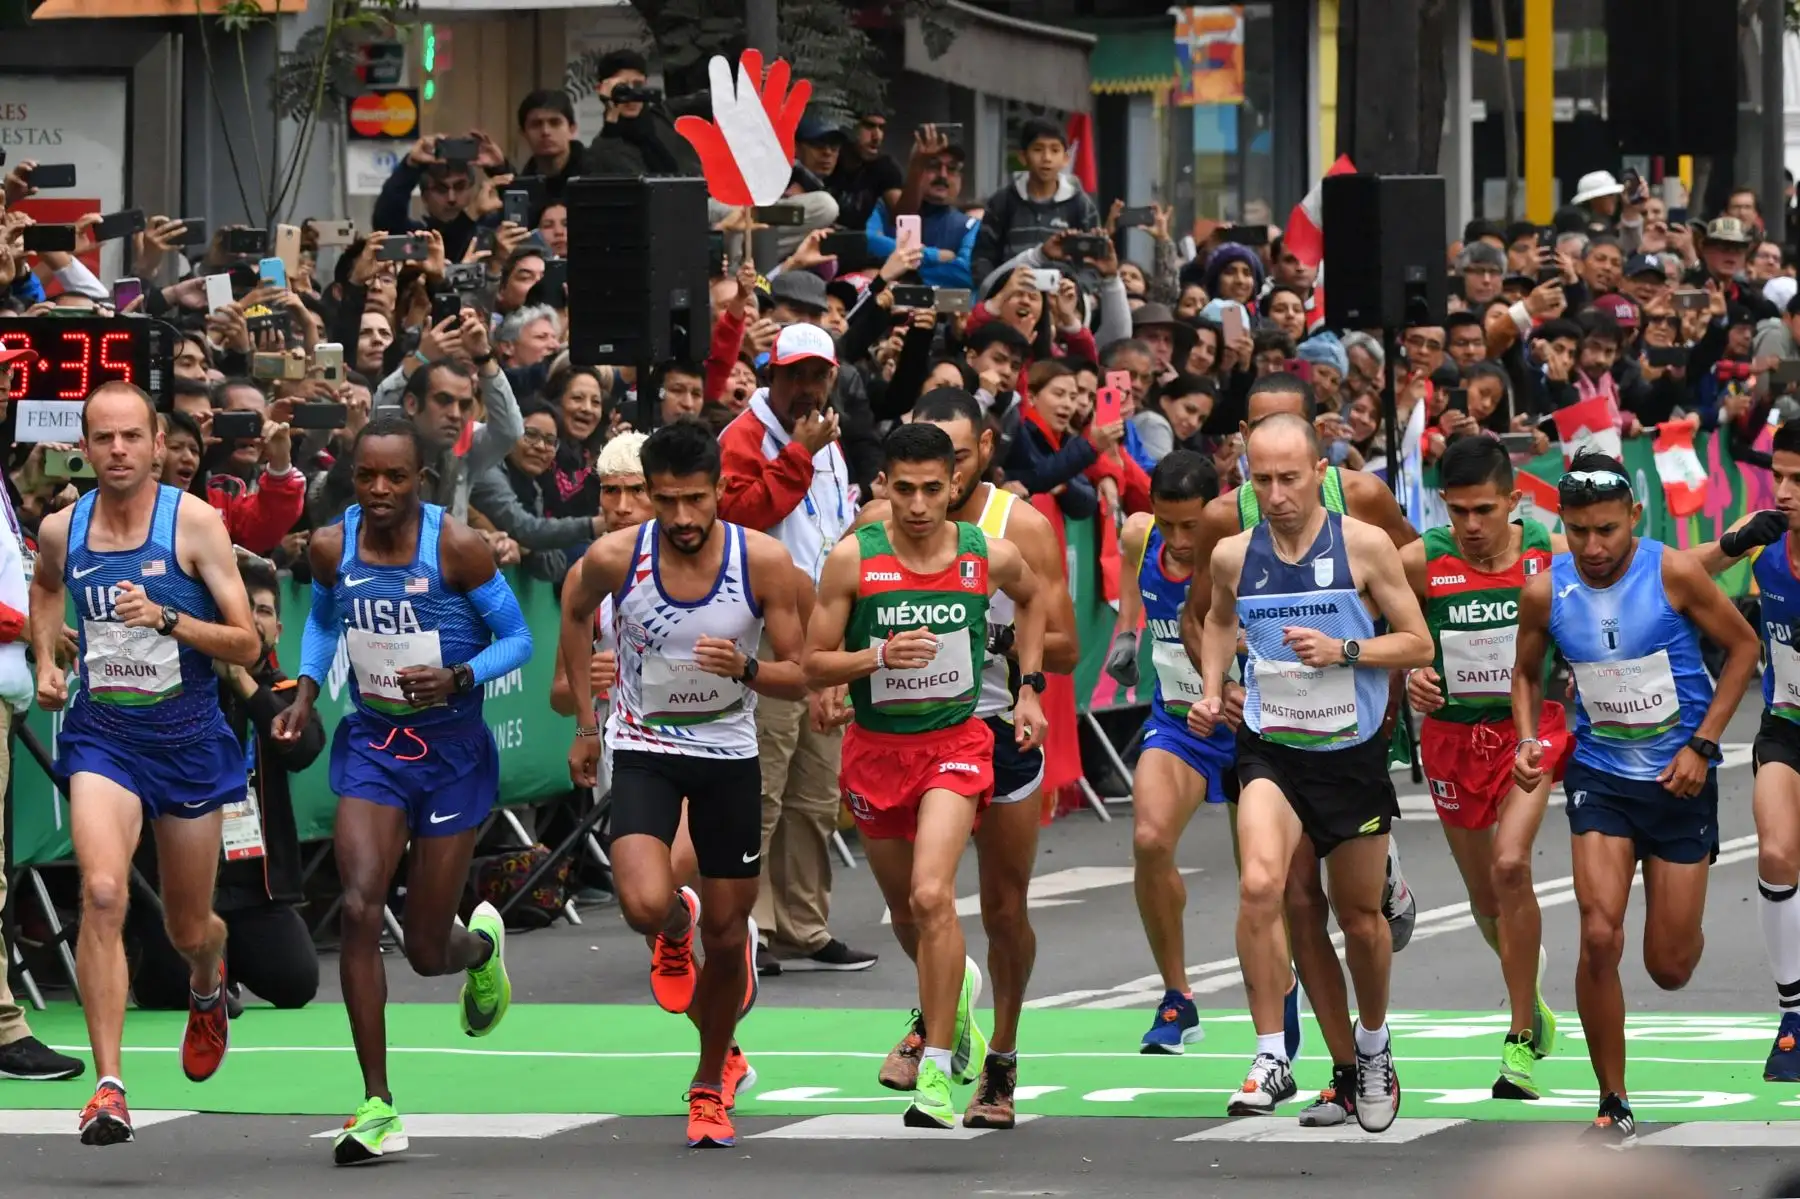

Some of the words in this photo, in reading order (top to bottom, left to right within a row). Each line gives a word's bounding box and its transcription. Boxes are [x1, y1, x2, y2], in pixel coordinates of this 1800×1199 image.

[354, 598, 423, 635] USA
[877, 601, 966, 625] MÉXICO
[1248, 603, 1339, 620] ARGENTINA
[105, 664, 157, 677] BRAUN
[885, 670, 959, 690] PACHECO
[668, 689, 720, 704] AYALA
[1296, 689, 1308, 697] 20
[1262, 702, 1355, 720] MASTROMARINO
[1592, 693, 1663, 715] TRUJILLO
